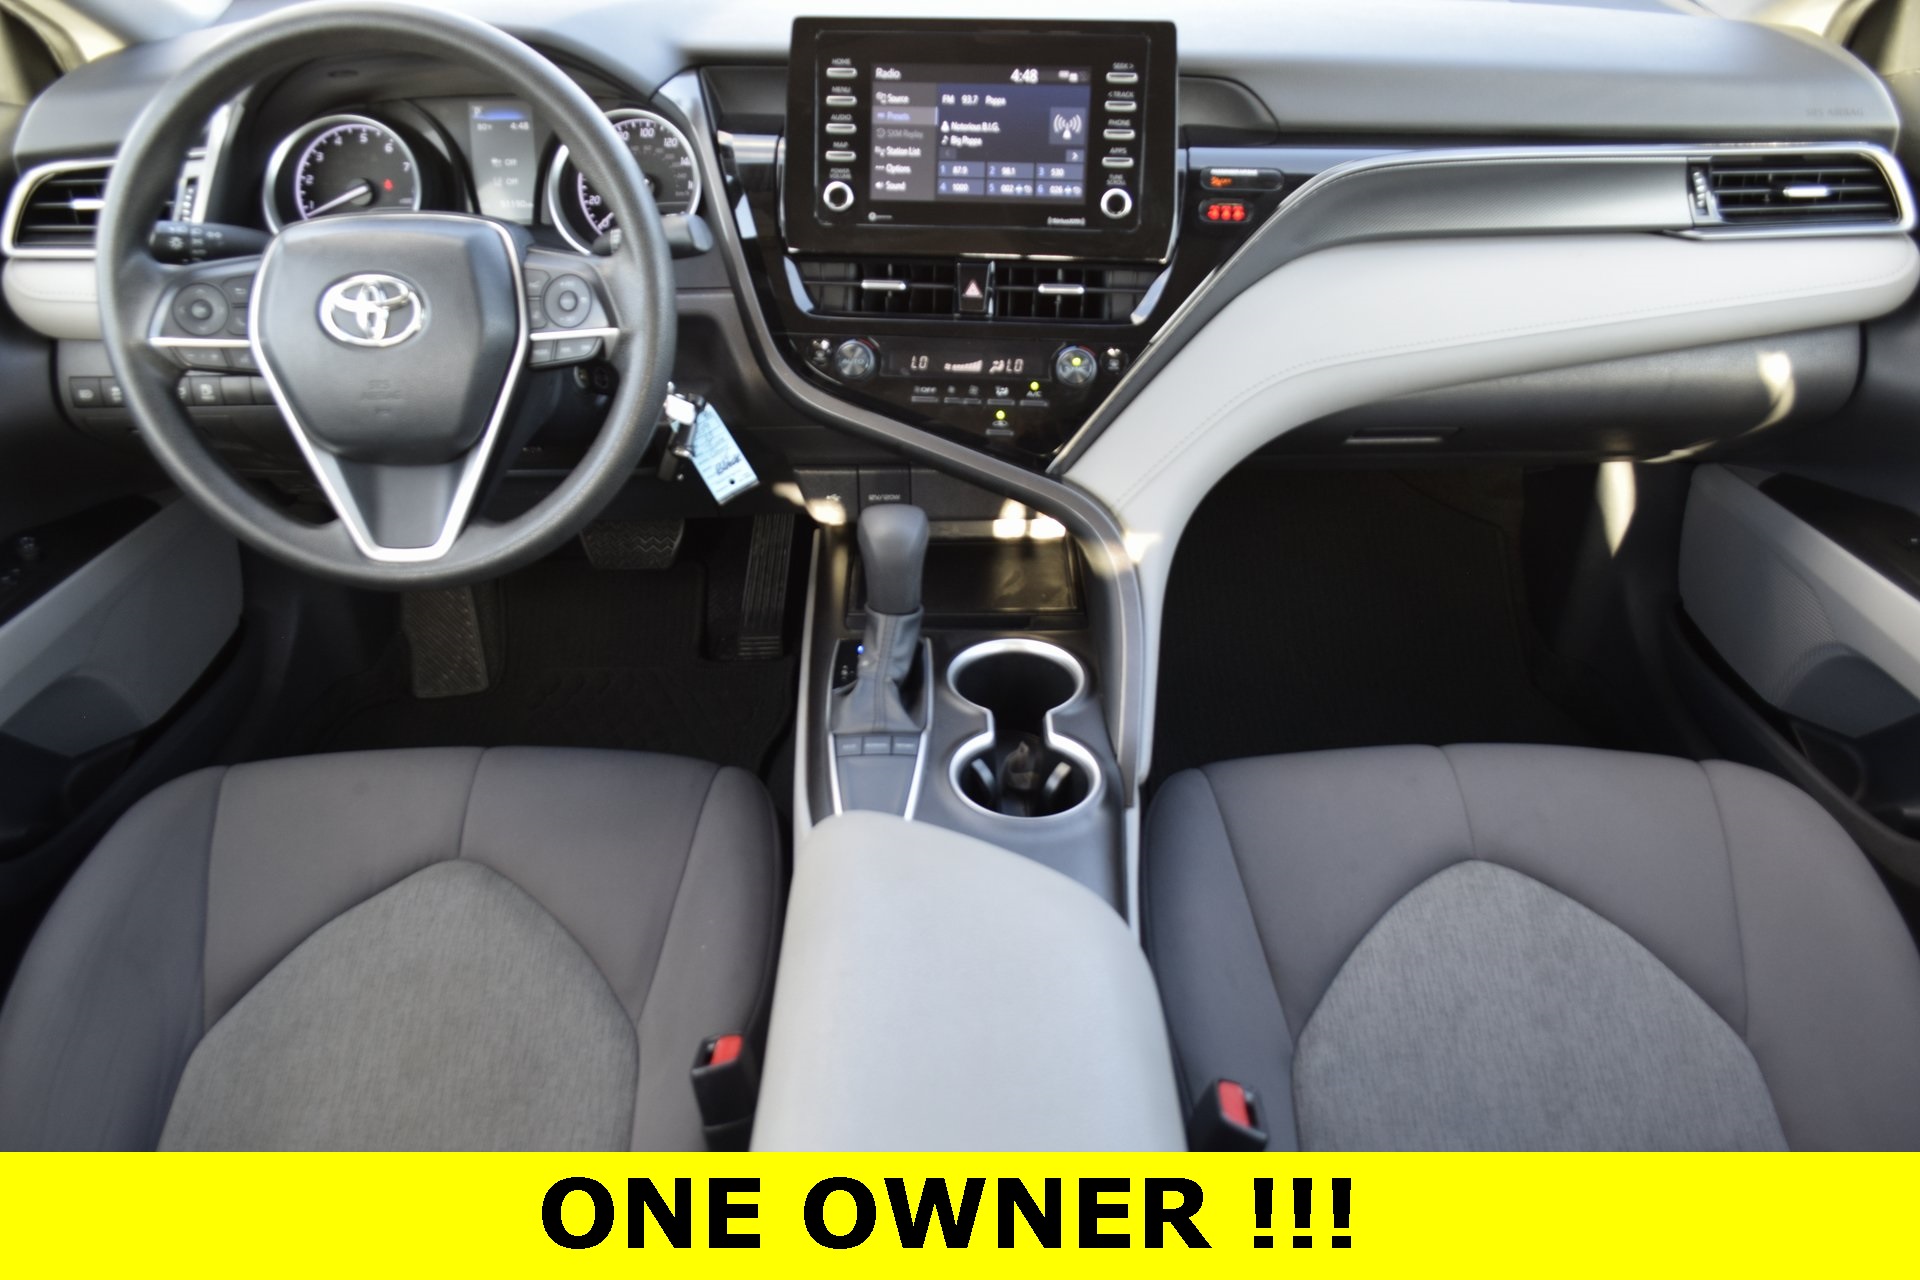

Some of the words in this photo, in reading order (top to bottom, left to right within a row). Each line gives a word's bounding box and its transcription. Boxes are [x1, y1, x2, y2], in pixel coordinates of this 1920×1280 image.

[1113, 62, 1128, 70] SEEK
[875, 67, 901, 80] Radio
[1010, 68, 1039, 84] 4:48
[887, 94, 909, 104] Source
[942, 94, 955, 105] FM
[961, 94, 979, 105] 93.7
[830, 113, 852, 121] AUDIO
[951, 121, 982, 132] Notorious
[1108, 119, 1131, 127] PHONE
[359, 133, 368, 143] 5
[640, 127, 655, 138] 100
[334, 136, 343, 146] 4
[664, 137, 679, 148] 120
[951, 136, 963, 146] Big
[384, 142, 394, 154] 6
[886, 146, 908, 157] Station
[908, 146, 922, 157] List
[315, 151, 325, 162] 3
[402, 161, 411, 172] 7
[885, 164, 911, 175] Options
[305, 174, 315, 185] 2
[885, 181, 906, 191] Sound
[588, 195, 601, 205] 20
